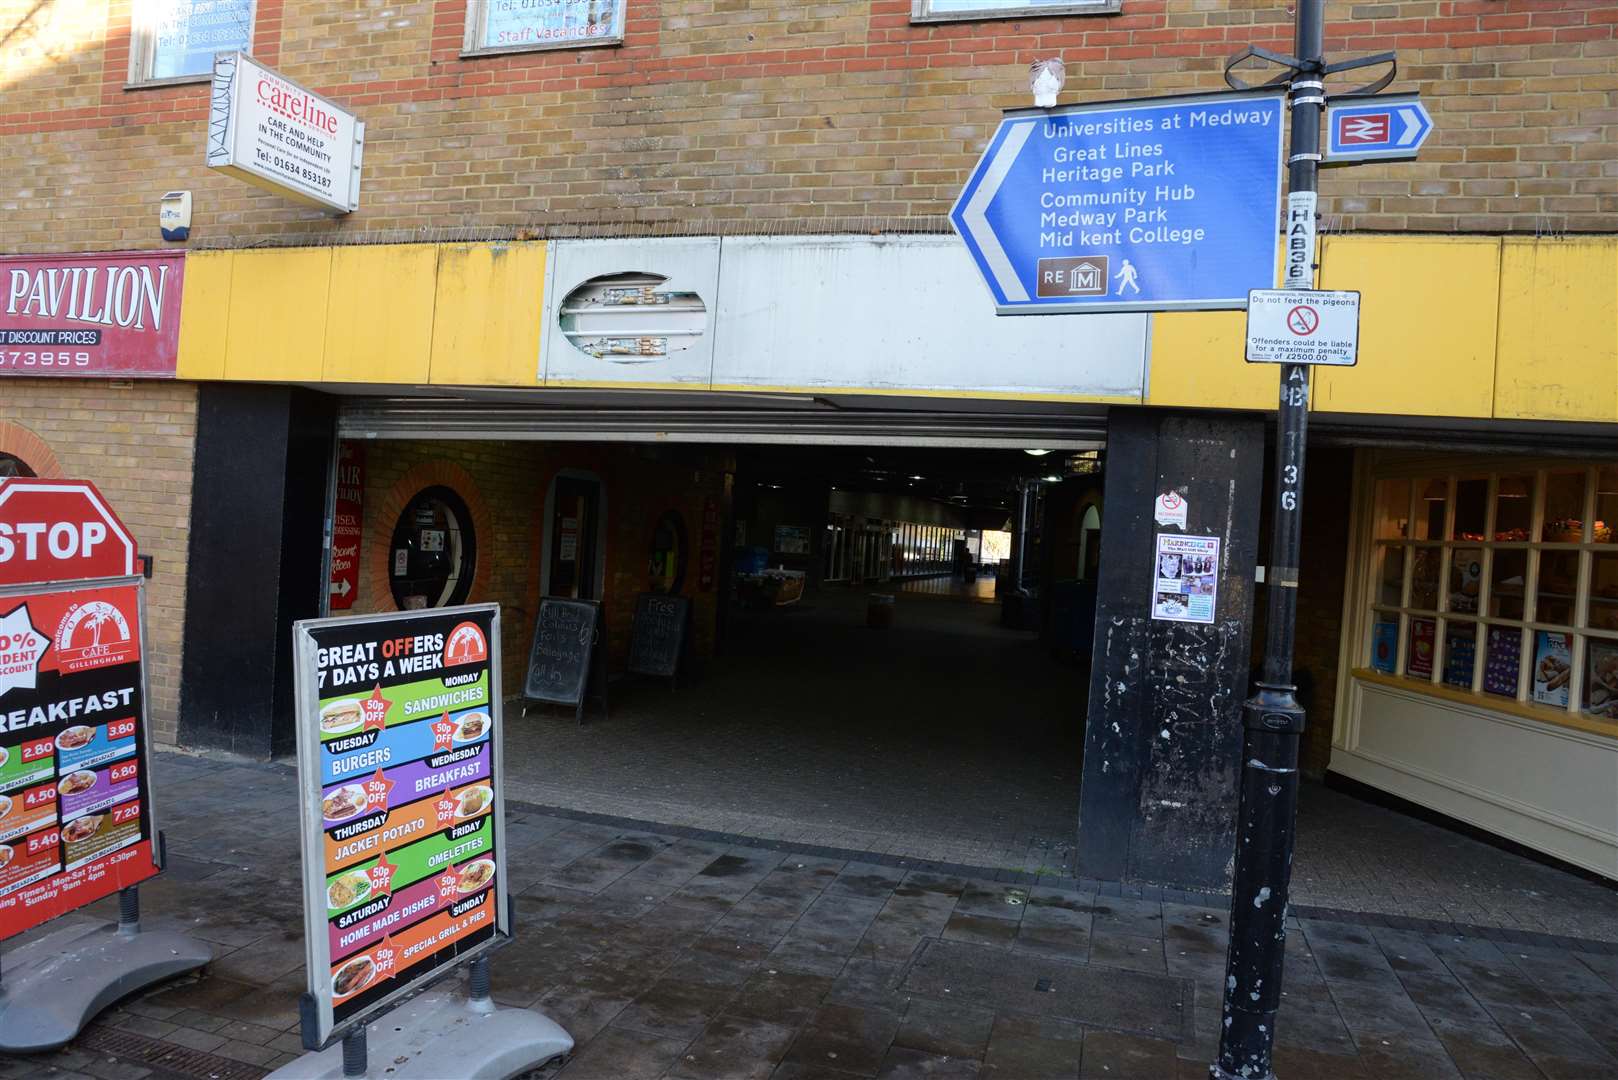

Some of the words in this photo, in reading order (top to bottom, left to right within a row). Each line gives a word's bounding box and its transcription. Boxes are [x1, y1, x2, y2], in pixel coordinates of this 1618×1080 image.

[498, 27, 531, 43] Staff
[536, 23, 605, 39] Vacancies
[257, 79, 337, 134] Careline
[267, 116, 287, 132] CARE
[289, 127, 305, 140] AND
[307, 135, 324, 149] HELP
[1042, 119, 1154, 140] Universities
[1161, 115, 1182, 130] at
[1189, 109, 1273, 129] Medway
[258, 123, 267, 134] IN
[270, 127, 283, 142] THE
[285, 136, 331, 163] COMMUNITY
[1053, 146, 1107, 163] Great
[1114, 141, 1163, 159] Lines
[256, 147, 272, 164] Tel:
[274, 155, 300, 176] 01634
[302, 167, 331, 189] 853187
[1042, 165, 1123, 186] Heritage
[1131, 161, 1175, 177] Park
[1040, 189, 1147, 213] Community
[1154, 184, 1196, 201] Hub
[1040, 212, 1117, 232] Medway
[1124, 207, 1168, 223] Park
[1039, 229, 1073, 247] Mid
[1080, 227, 1122, 245] kent
[1129, 225, 1205, 247] College
[1044, 270, 1064, 284] RE
[6, 265, 169, 331] PAVILION
[1252, 295, 1263, 304] Do
[1267, 296, 1281, 304] not
[1284, 297, 1303, 305] feed
[1306, 297, 1320, 305] the
[1323, 298, 1356, 306] pigeons
[8, 331, 55, 344] DISCOUNT
[58, 331, 97, 345] PRICES
[1251, 337, 1291, 346] Offenders
[1293, 339, 1316, 347] could
[1331, 340, 1353, 348] liable
[1277, 346, 1316, 354] maximum
[1318, 347, 1348, 356] penalty
[1286, 353, 1328, 361] £2500.00
[337, 464, 361, 486] AIR
[54, 611, 71, 651] welcome
[68, 603, 79, 612] to
[0, 650, 37, 665] DENT
[81, 645, 111, 658] CAFE
[317, 641, 378, 668] GREAT
[382, 633, 444, 658] OFFERS
[0, 663, 34, 676] COUNT
[69, 655, 125, 670] GILLINGHAM
[317, 670, 328, 689] 7
[333, 662, 380, 686] DAYS
[383, 660, 396, 678] A
[399, 652, 444, 675] WEEK
[444, 672, 479, 687] MONDAY
[366, 700, 384, 712] 50p
[403, 687, 484, 716] SANDWICHES
[366, 711, 385, 722] OFF
[108, 722, 135, 736] 3.80
[435, 723, 452, 734] 50p
[329, 732, 376, 753] TUESDAY
[435, 733, 452, 744] OFF
[23, 742, 54, 758] 2.80
[431, 745, 481, 768] WEDNESDAY
[332, 747, 391, 776] BURGERS
[111, 764, 137, 780] 6.80
[415, 762, 481, 793] BREAKFAST
[26, 788, 56, 804] 4.50
[369, 781, 386, 793] 50p
[368, 791, 387, 804] OFF
[437, 800, 454, 812] 50p
[112, 805, 140, 822] 7.20
[437, 809, 454, 821] OFF
[335, 814, 388, 840] THURSDAY
[452, 819, 481, 839] FRIDAY
[29, 832, 60, 851] 5.40
[334, 832, 381, 861] JACKET
[382, 817, 426, 842] POTATO
[428, 836, 484, 867] OMELETTES
[18, 884, 45, 901] Times
[52, 869, 86, 888] Mon-Sat
[88, 861, 105, 876] 7am
[110, 849, 138, 865] 5.30pm
[372, 866, 390, 878] 50p
[441, 875, 457, 887] 50p
[25, 888, 59, 907] Sunday
[62, 879, 81, 892] 9am
[88, 869, 105, 882] 4pm
[371, 877, 391, 889] OFF
[440, 885, 457, 897] OFF
[339, 896, 391, 929] SATURDAY
[452, 894, 485, 917] SUNDAY
[339, 926, 371, 948] HOME
[372, 911, 401, 933] MADE
[402, 894, 436, 915] DISHES
[403, 934, 438, 959] SPECIAL
[438, 923, 461, 940] GRILL
[462, 919, 469, 927] &
[469, 910, 487, 926] PIES
[376, 948, 394, 961] 50p
[375, 959, 394, 973] OFF
